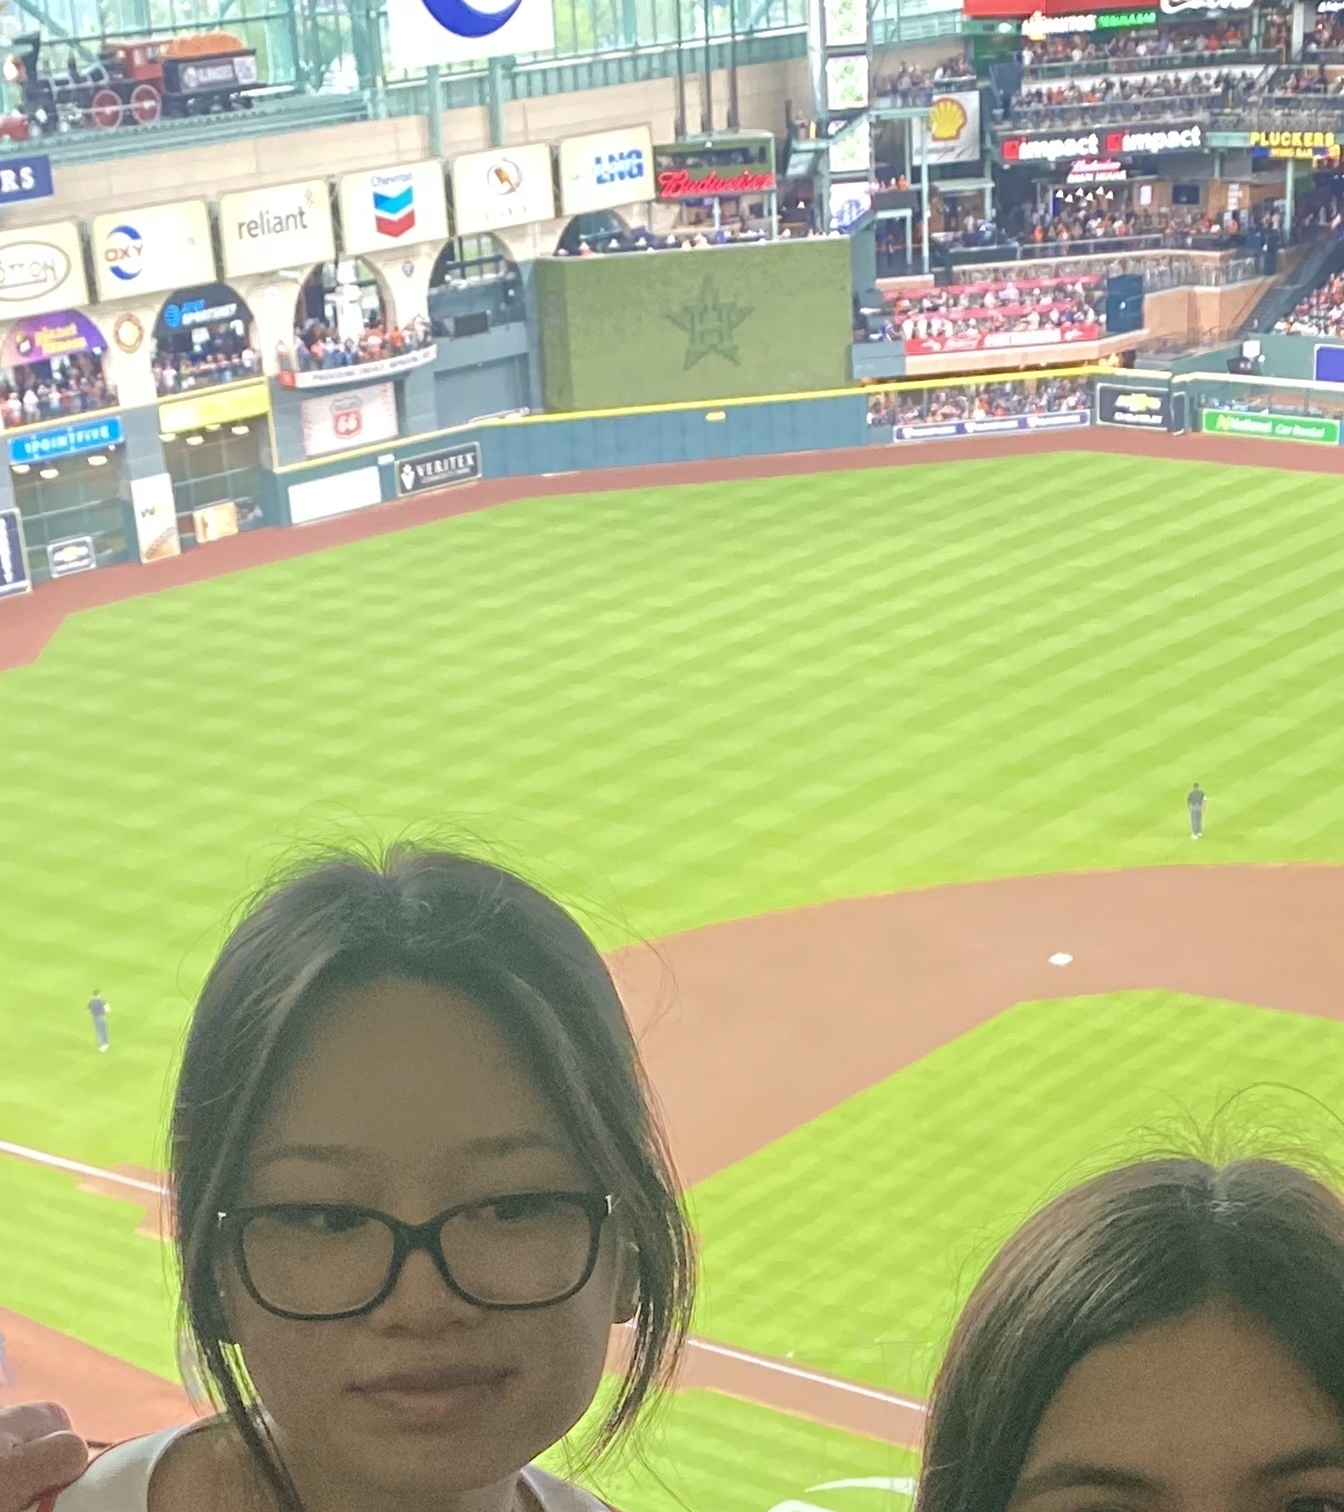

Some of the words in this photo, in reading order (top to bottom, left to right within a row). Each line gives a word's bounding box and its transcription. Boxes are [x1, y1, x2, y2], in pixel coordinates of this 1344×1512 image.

[1018, 134, 1099, 161] impact
[1122, 126, 1201, 152] impact
[1250, 131, 1336, 147] PLUCKERS
[594, 148, 645, 186] LNG
[657, 170, 773, 198] Budweiser
[237, 205, 309, 240] reliant
[415, 451, 476, 477] VERITEX
